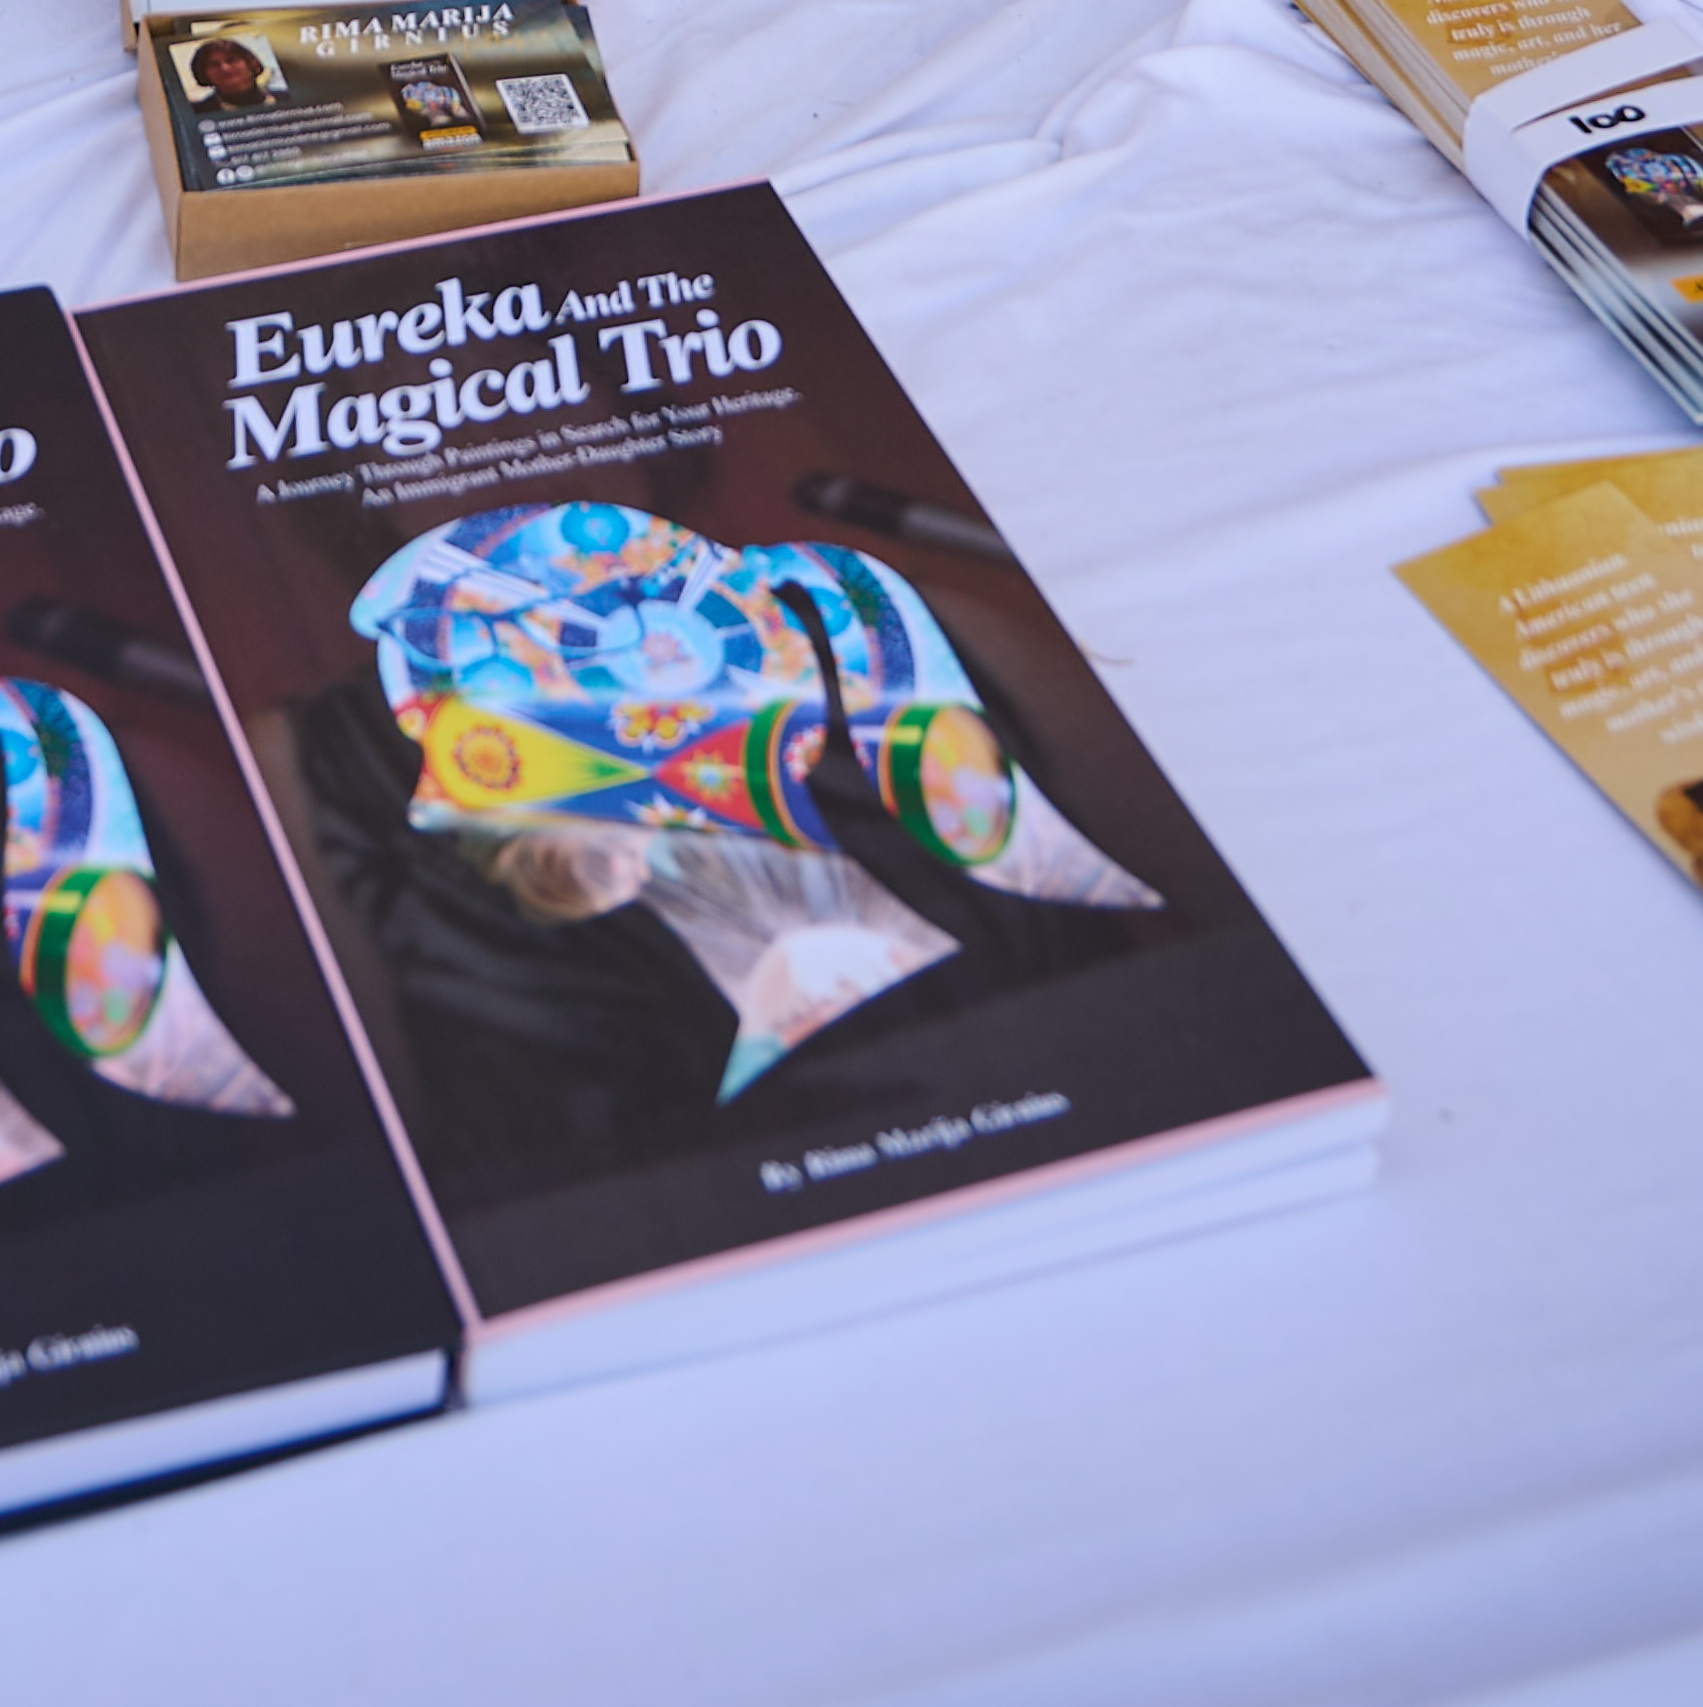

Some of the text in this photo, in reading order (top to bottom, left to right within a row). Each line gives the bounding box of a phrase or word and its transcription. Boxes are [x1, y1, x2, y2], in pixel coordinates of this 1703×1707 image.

[299, 2, 516, 45] RIMA MARIJA
[1426, 1, 1509, 26] discovers
[1451, 7, 1592, 42] truly is through
[1452, 20, 1623, 62] magic, art, and her
[1569, 105, 1646, 135] 100
[225, 271, 714, 388] Eureka And The
[224, 309, 783, 470] Magical Trio
[256, 483, 276, 505] A
[277, 472, 355, 501] Journey
[356, 453, 445, 484] Through
[444, 436, 538, 467] Paintings
[537, 429, 562, 450] in
[560, 415, 631, 444] Search
[631, 410, 661, 432] for
[661, 403, 710, 425] Your
[362, 425, 723, 509] An Immigrant Mother-Daughter Story
[759, 1089, 1072, 1193] By Rima Marija Girnius
[26, 1323, 140, 1372] Girnius
